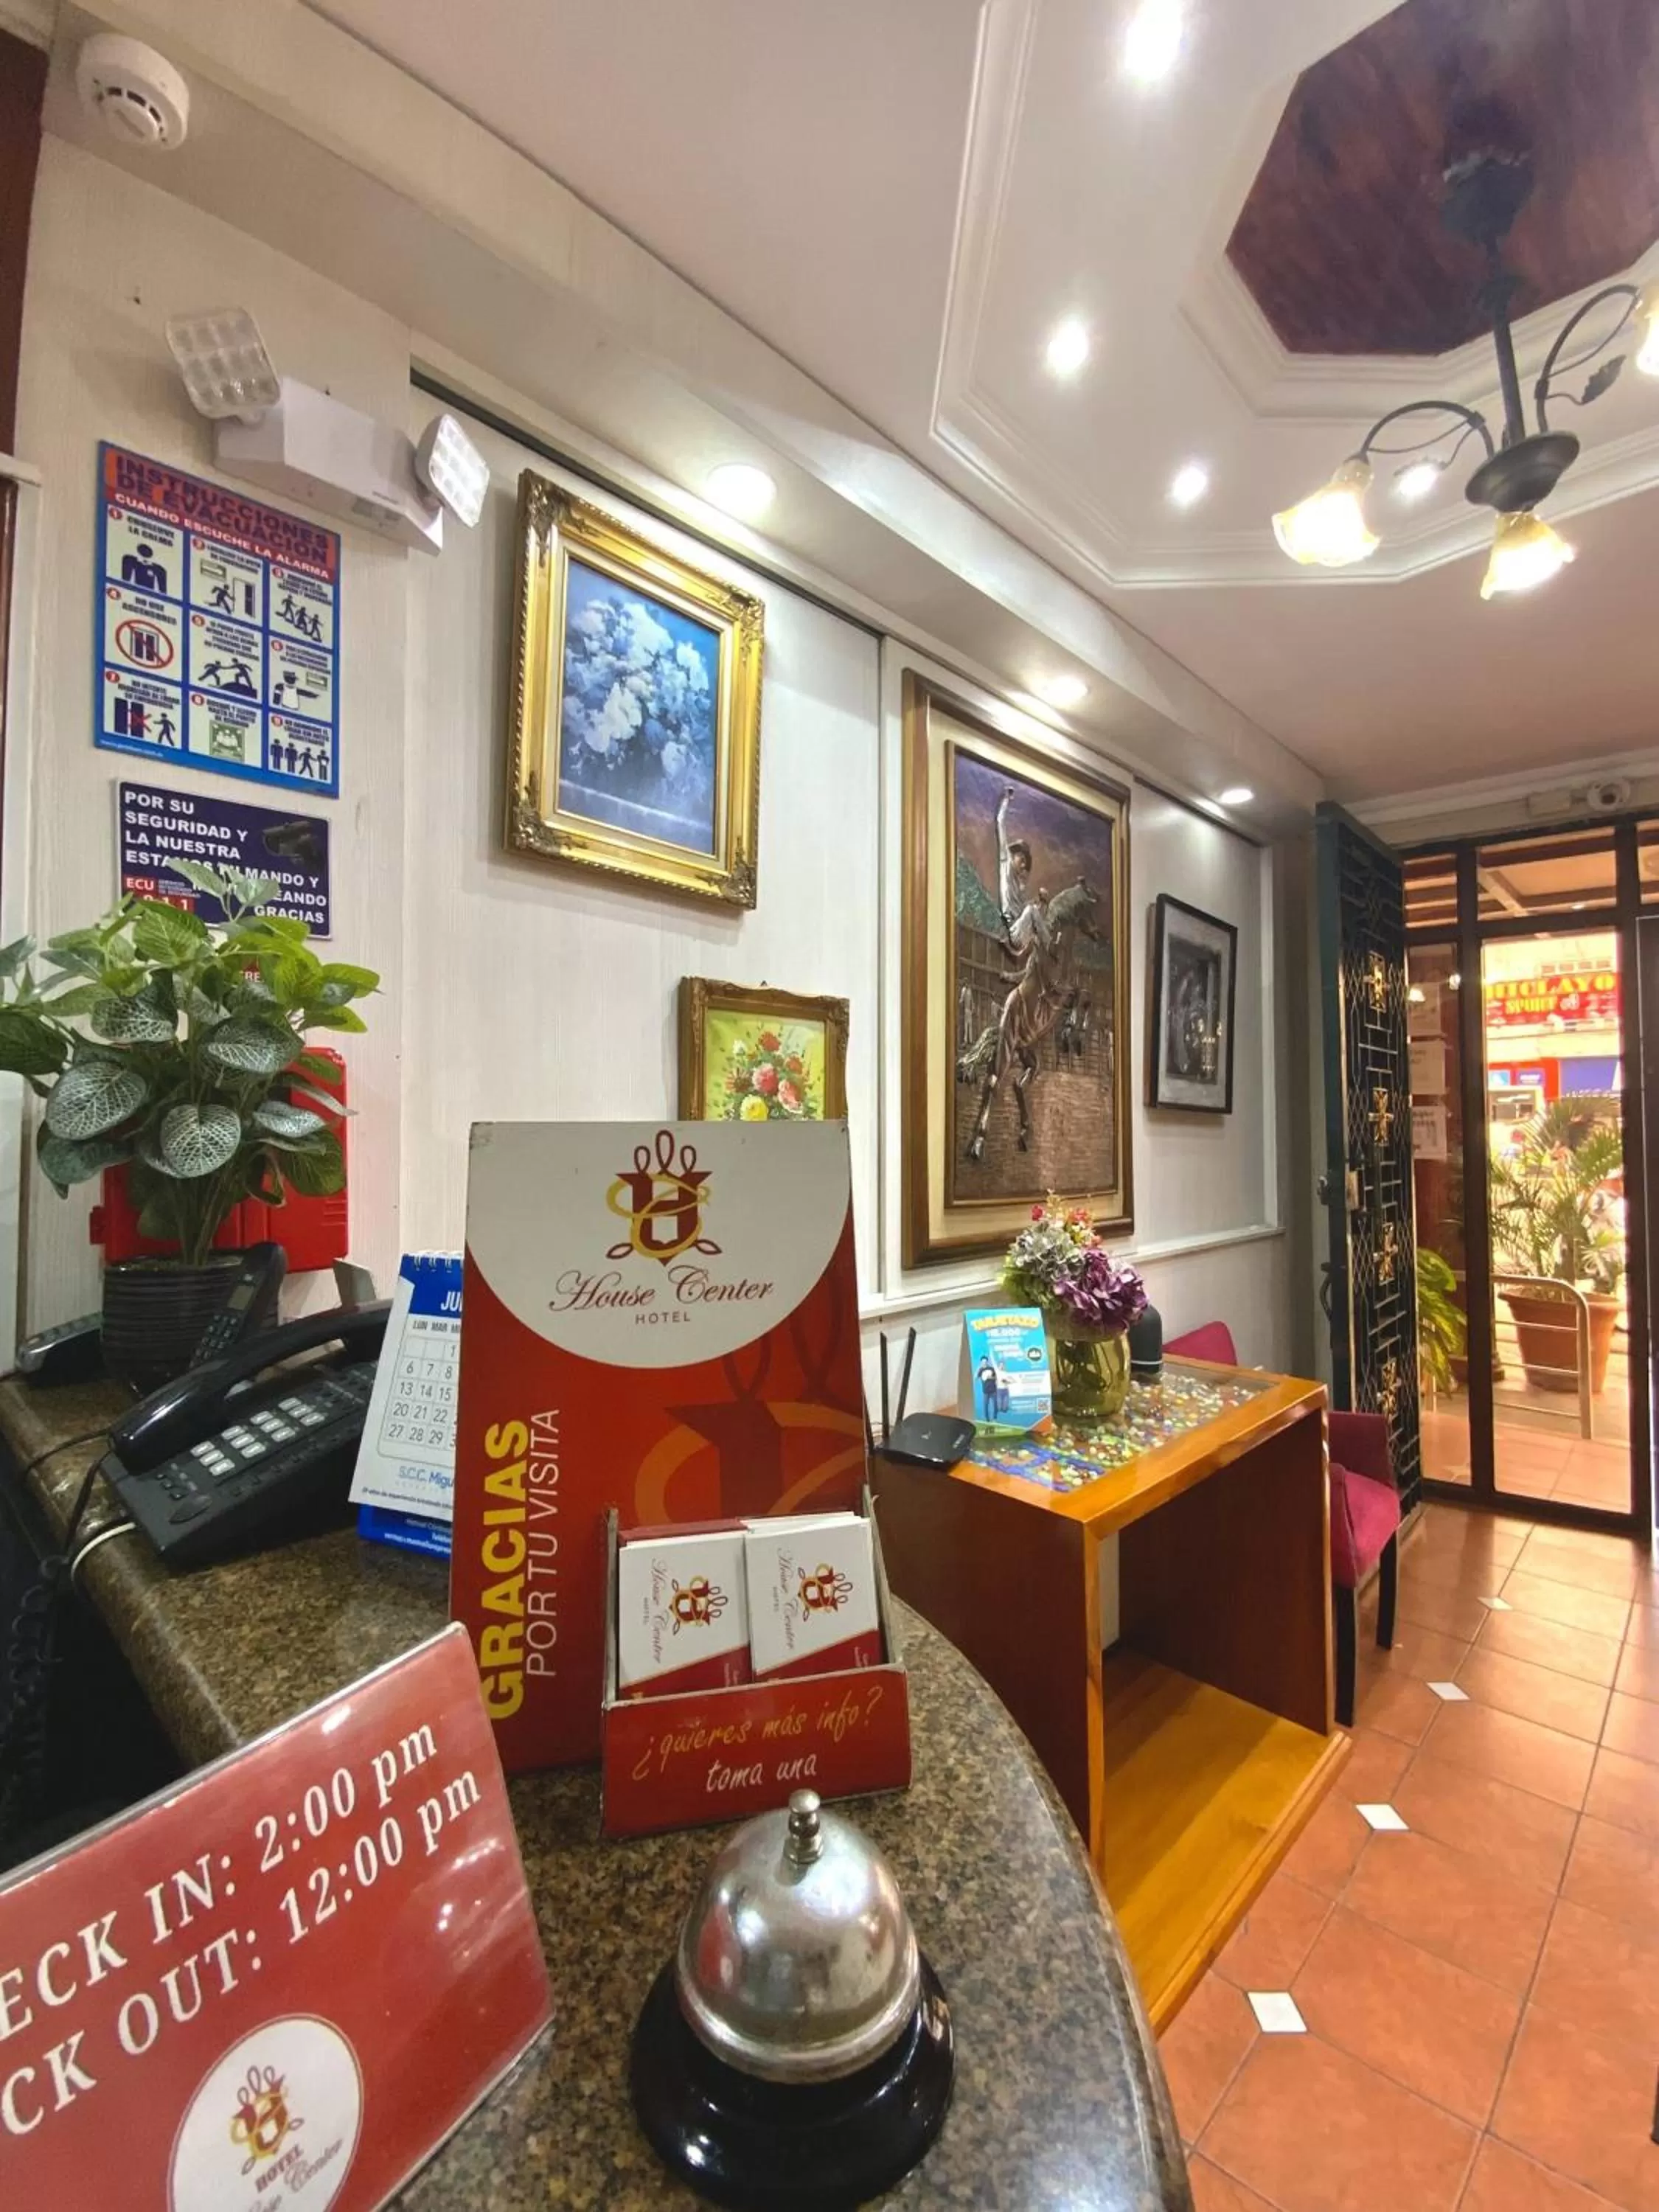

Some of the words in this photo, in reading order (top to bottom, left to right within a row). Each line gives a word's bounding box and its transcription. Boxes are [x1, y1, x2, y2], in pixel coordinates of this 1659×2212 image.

[116, 474, 152, 498] DE
[116, 456, 329, 550] INSTRUCCIONES
[115, 493, 179, 523] CUANDO
[184, 519, 251, 550] ESCUCHE
[254, 545, 272, 559] LA
[276, 553, 329, 579] ALARMA
[125, 790, 164, 810] POR
[170, 799, 194, 815] SU
[125, 811, 231, 840] SEGURIDAD
[237, 830, 248, 842] Y
[125, 830, 150, 846] LA
[156, 835, 240, 860] NUESTRA
[126, 877, 154, 891] ECU
[310, 877, 319, 888] Y
[254, 904, 324, 924] GRACIAS
[549, 1269, 655, 1312] House
[668, 1265, 775, 1305] Center
[413, 1320, 427, 1330] LUN
[431, 1322, 448, 1332] MAR
[635, 1310, 691, 1326] HOTEL
[450, 1344, 456, 1357] 1
[406, 1360, 414, 1374] 6
[427, 1363, 434, 1377] 7
[445, 1366, 453, 1380] 8
[400, 1381, 414, 1396] 13
[420, 1383, 433, 1398] 14
[439, 1386, 452, 1402] 15
[393, 1402, 409, 1417] 20
[413, 1405, 428, 1420] 21
[433, 1408, 448, 1424] 22
[389, 1424, 405, 1439] 27
[408, 1427, 424, 1442] 28
[428, 1429, 444, 1445] 29
[529, 1409, 560, 1521] VISITA
[480, 1419, 529, 1720] GRACIAS
[528, 1532, 558, 1582] TU
[526, 1590, 557, 1677] POR
[632, 1719, 754, 1781] ¿quieres
[762, 1704, 807, 1739] más
[816, 1686, 883, 1743] info?
[706, 1759, 763, 1794] toma
[776, 1753, 817, 1781] una
[145, 1854, 236, 1945] IN:
[255, 1767, 355, 1874] 2:00
[372, 1724, 437, 1809] pm
[117, 1929, 262, 2056] OUT:
[279, 1817, 403, 1944] 12:00
[417, 1770, 481, 1857] pm
[255, 2143, 304, 2194] HOTEL
